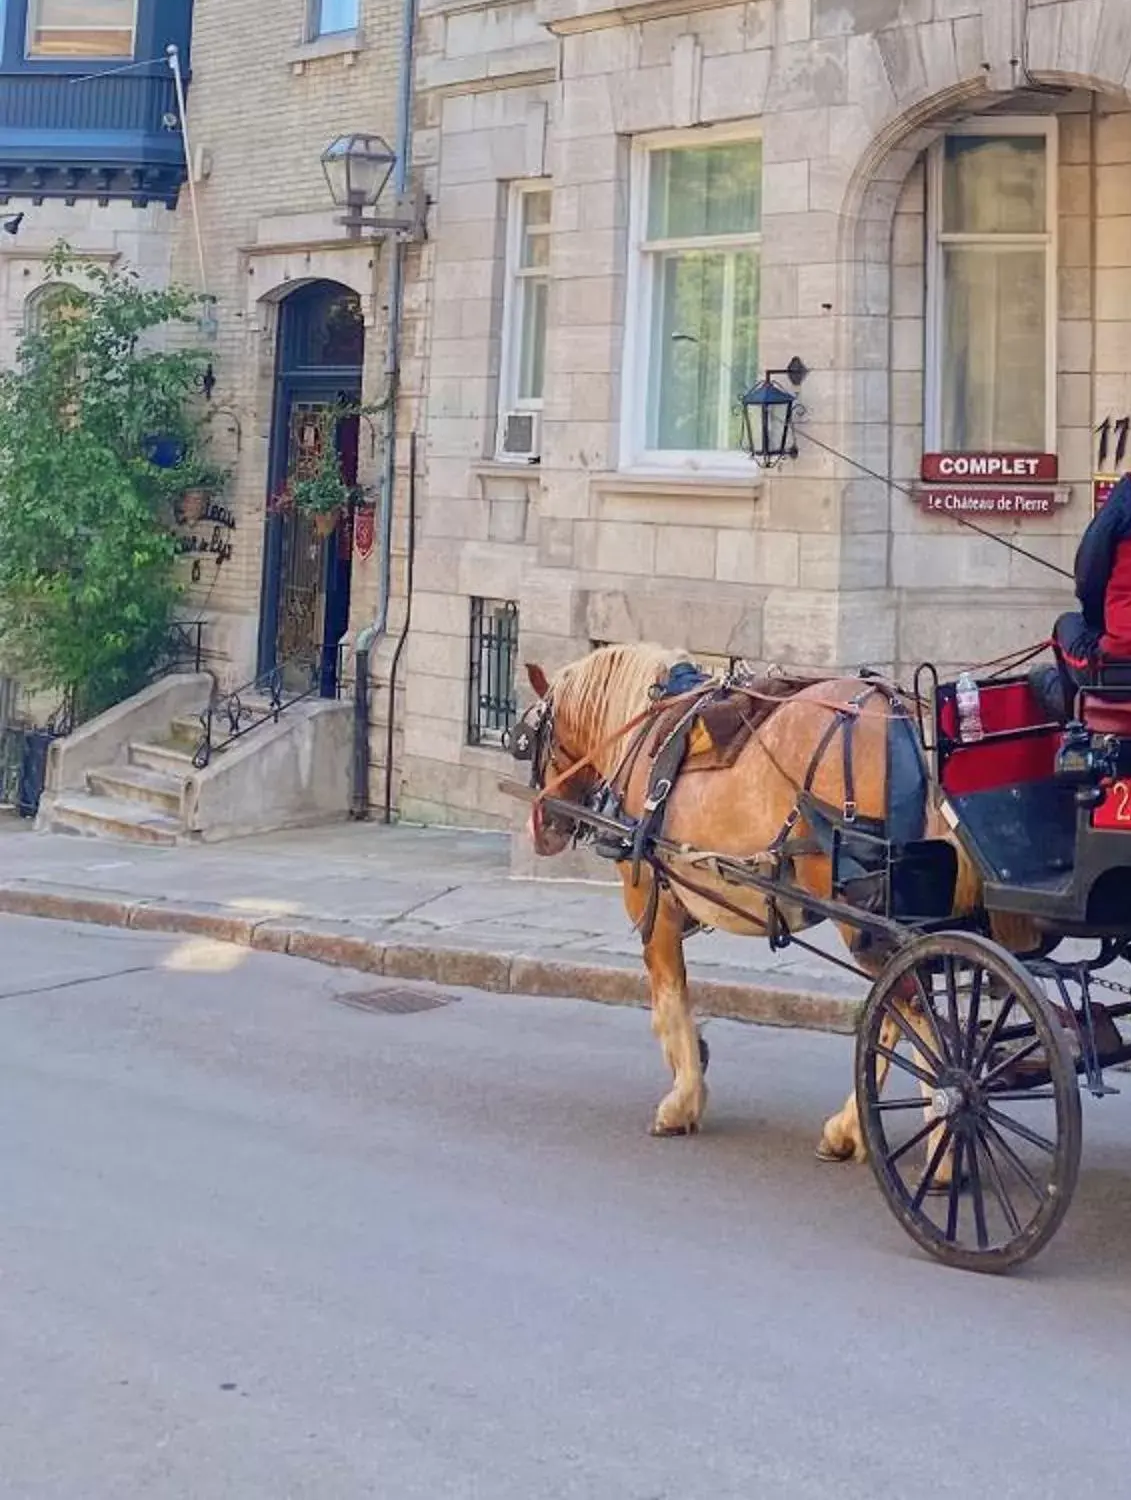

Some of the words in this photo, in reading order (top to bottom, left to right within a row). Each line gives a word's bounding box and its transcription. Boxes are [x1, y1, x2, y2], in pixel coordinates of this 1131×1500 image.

[1095, 415, 1130, 470] 17
[939, 457, 1039, 475] COMPLET
[944, 494, 995, 510] Château
[997, 495, 1012, 511] de
[1014, 495, 1049, 512] Pierre
